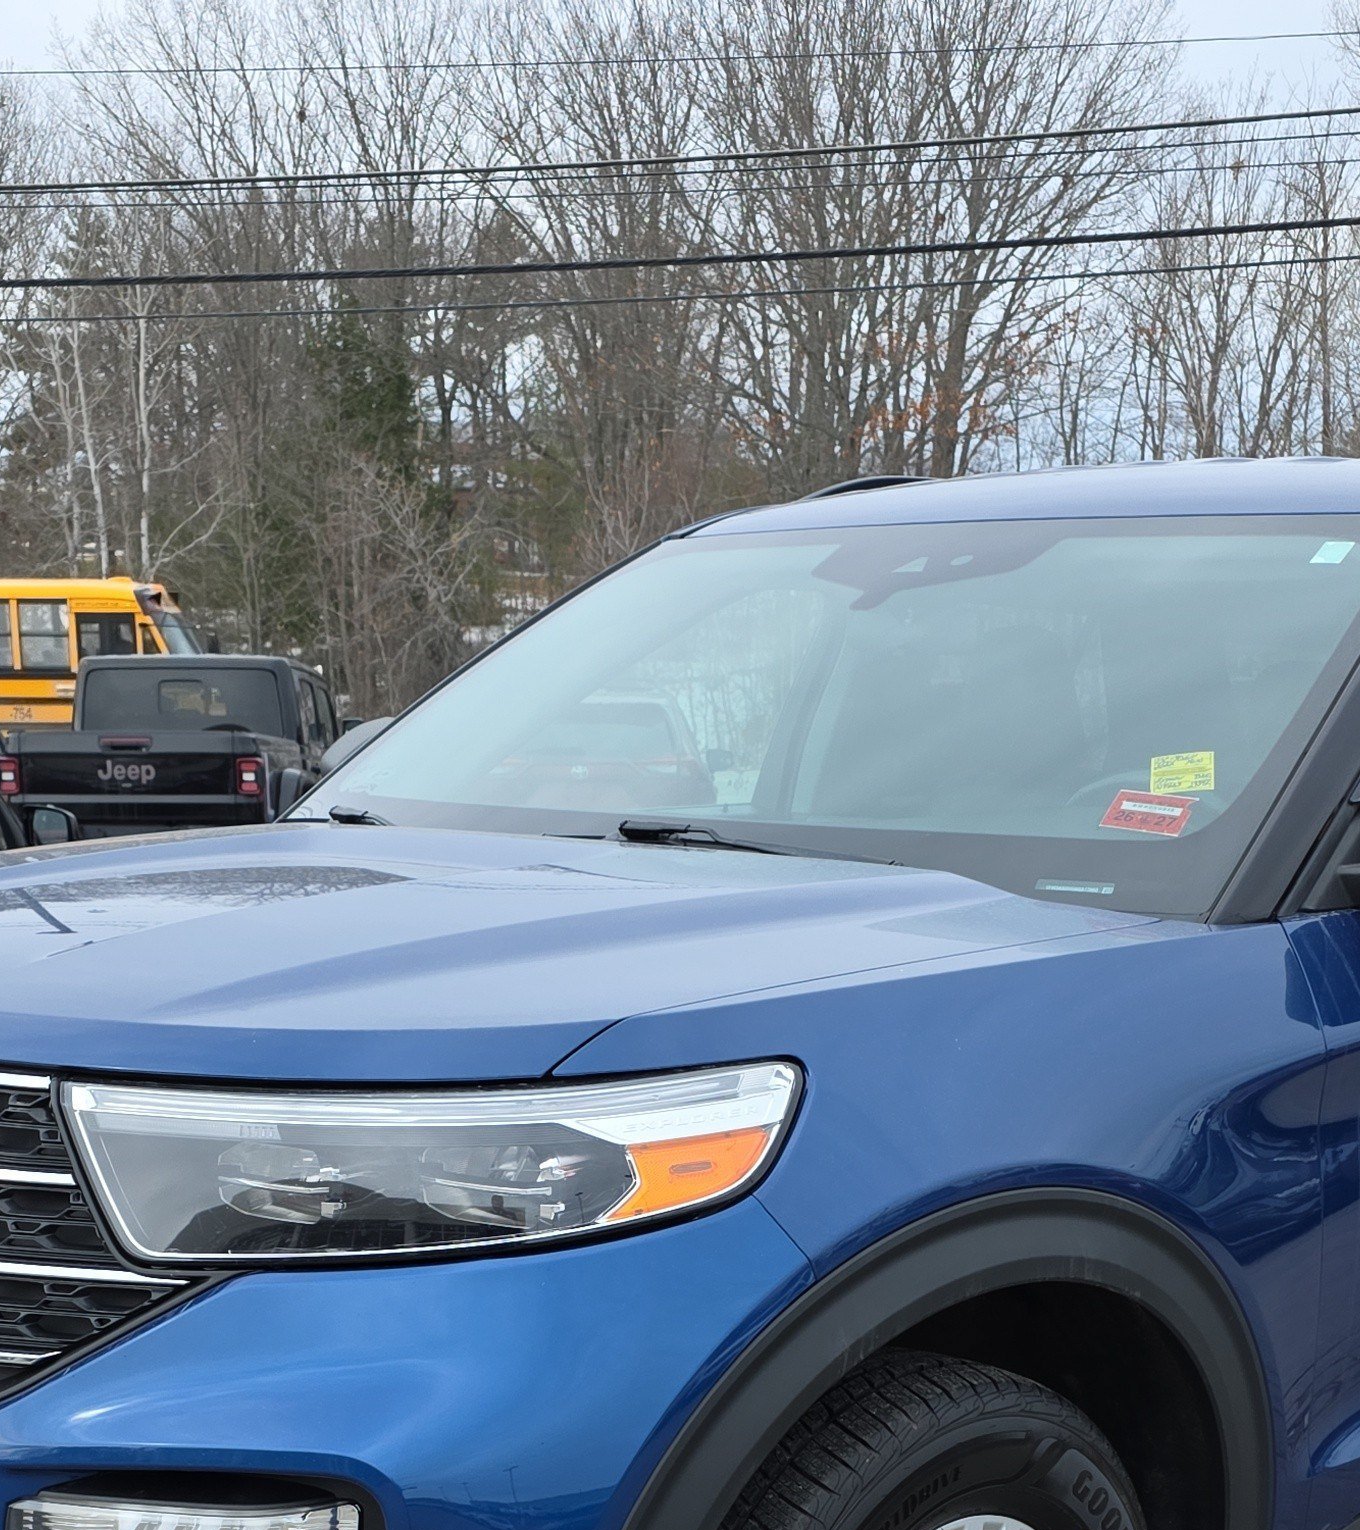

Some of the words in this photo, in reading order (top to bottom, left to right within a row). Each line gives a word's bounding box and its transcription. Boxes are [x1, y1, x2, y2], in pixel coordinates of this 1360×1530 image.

[97, 759, 156, 785] Jeep
[1114, 811, 1135, 822] 26
[1154, 817, 1177, 827] 27
[624, 1106, 757, 1133] EXPLORER
